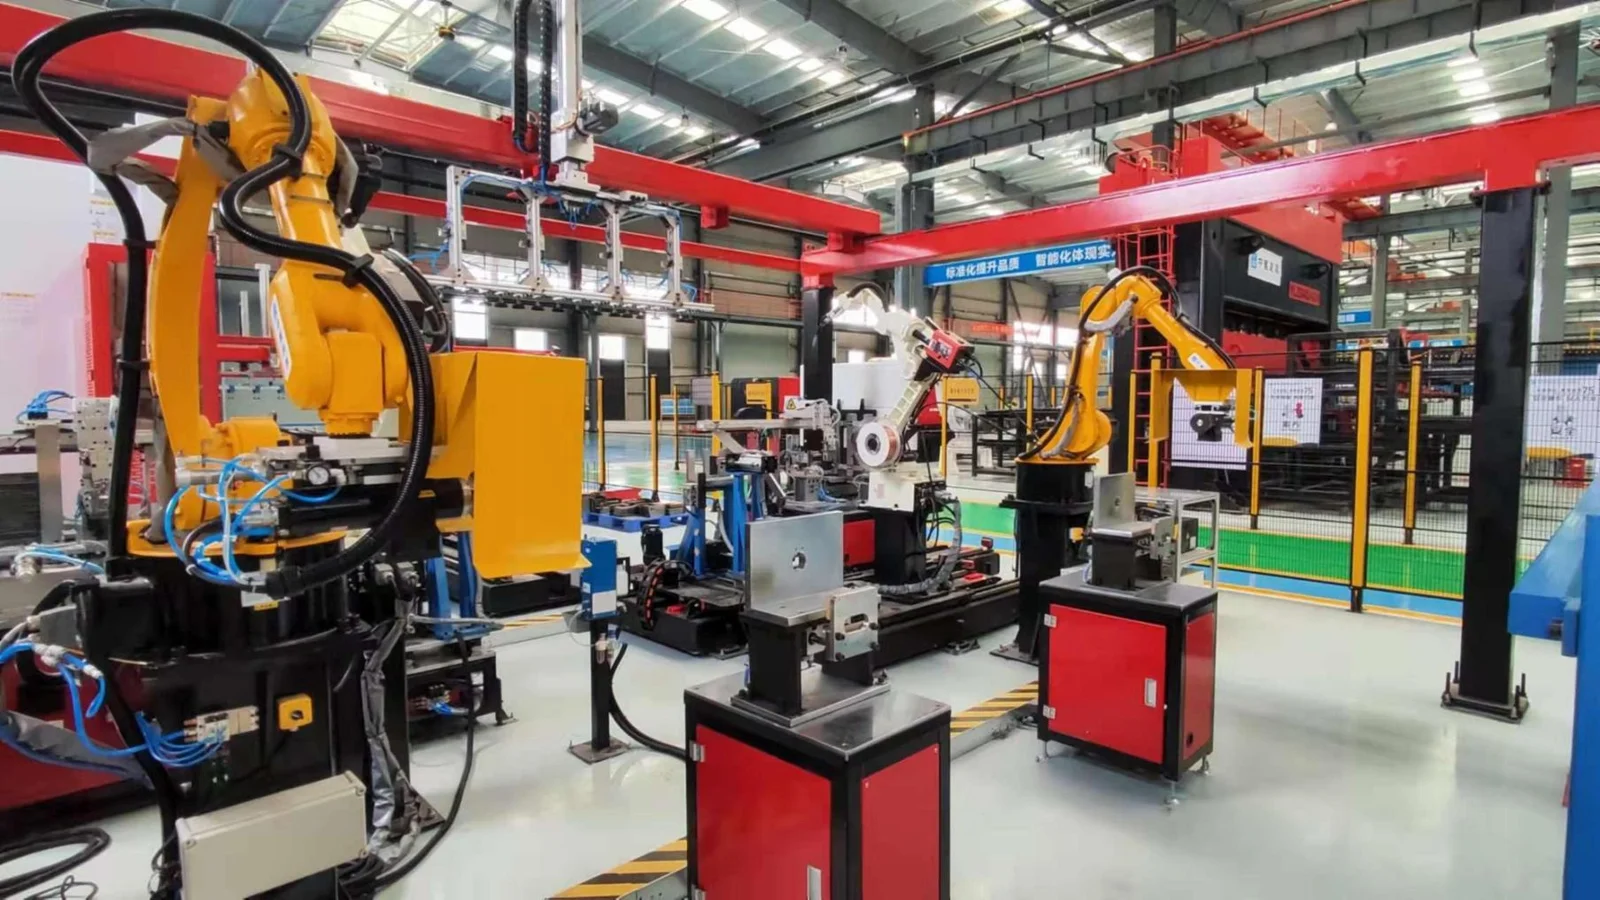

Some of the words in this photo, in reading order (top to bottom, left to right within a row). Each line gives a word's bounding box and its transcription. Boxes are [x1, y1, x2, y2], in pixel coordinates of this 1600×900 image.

[945, 257, 1020, 279] 标准化提升品质
[1035, 244, 1116, 267] 智能化体现实
